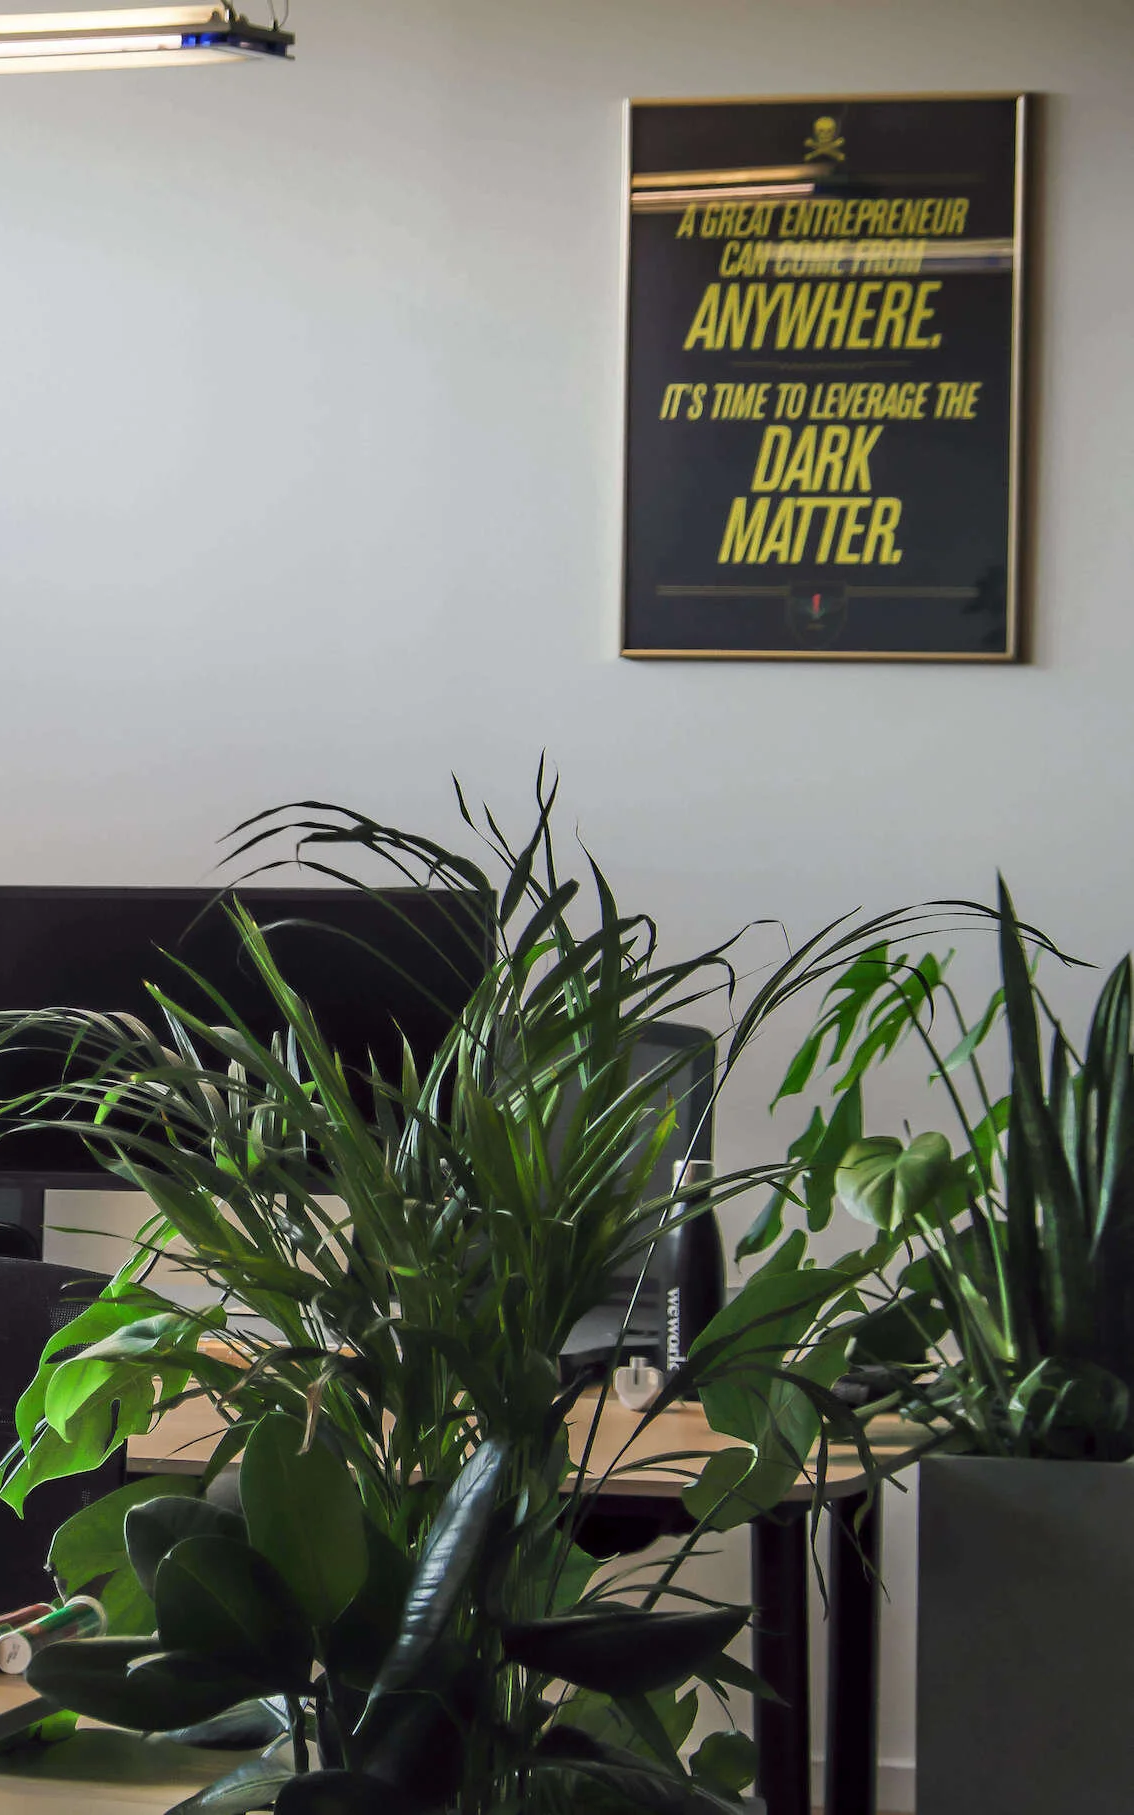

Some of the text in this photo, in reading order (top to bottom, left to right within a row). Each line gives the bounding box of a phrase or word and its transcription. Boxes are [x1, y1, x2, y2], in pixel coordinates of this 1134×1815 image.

[675, 199, 969, 238] A GREAT ENTREPRENEUR
[719, 239, 927, 277] CAN COME FROM
[682, 280, 943, 351] ANYWHERE.
[659, 381, 983, 421] IT'S TIME TO LEVERAGE THE
[750, 424, 884, 493] DARK
[717, 496, 903, 565] MATTER.
